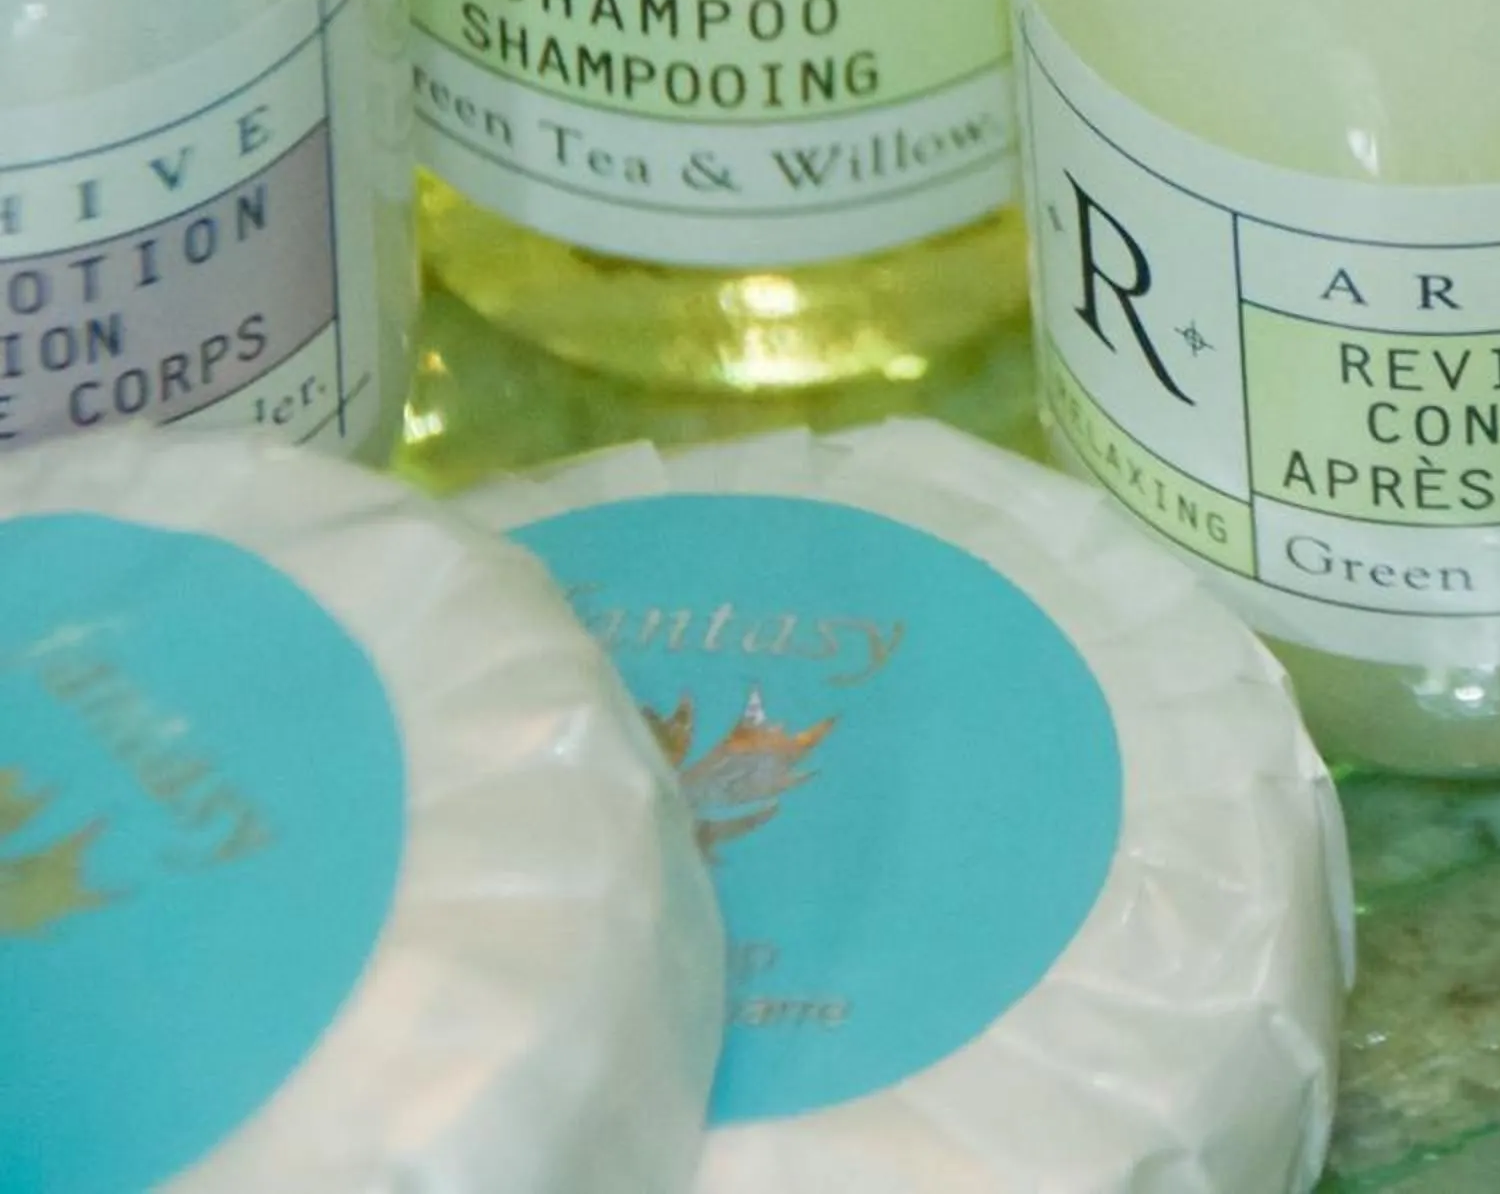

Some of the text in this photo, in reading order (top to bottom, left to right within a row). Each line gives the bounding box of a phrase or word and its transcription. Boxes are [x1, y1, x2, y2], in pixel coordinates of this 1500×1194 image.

[461, 2, 880, 108] SHAMPOOING
[410, 62, 514, 147] reen
[538, 118, 650, 187] Tea
[680, 152, 741, 194] &
[67, 314, 268, 428] CORPS
[1285, 535, 1475, 591] Green
